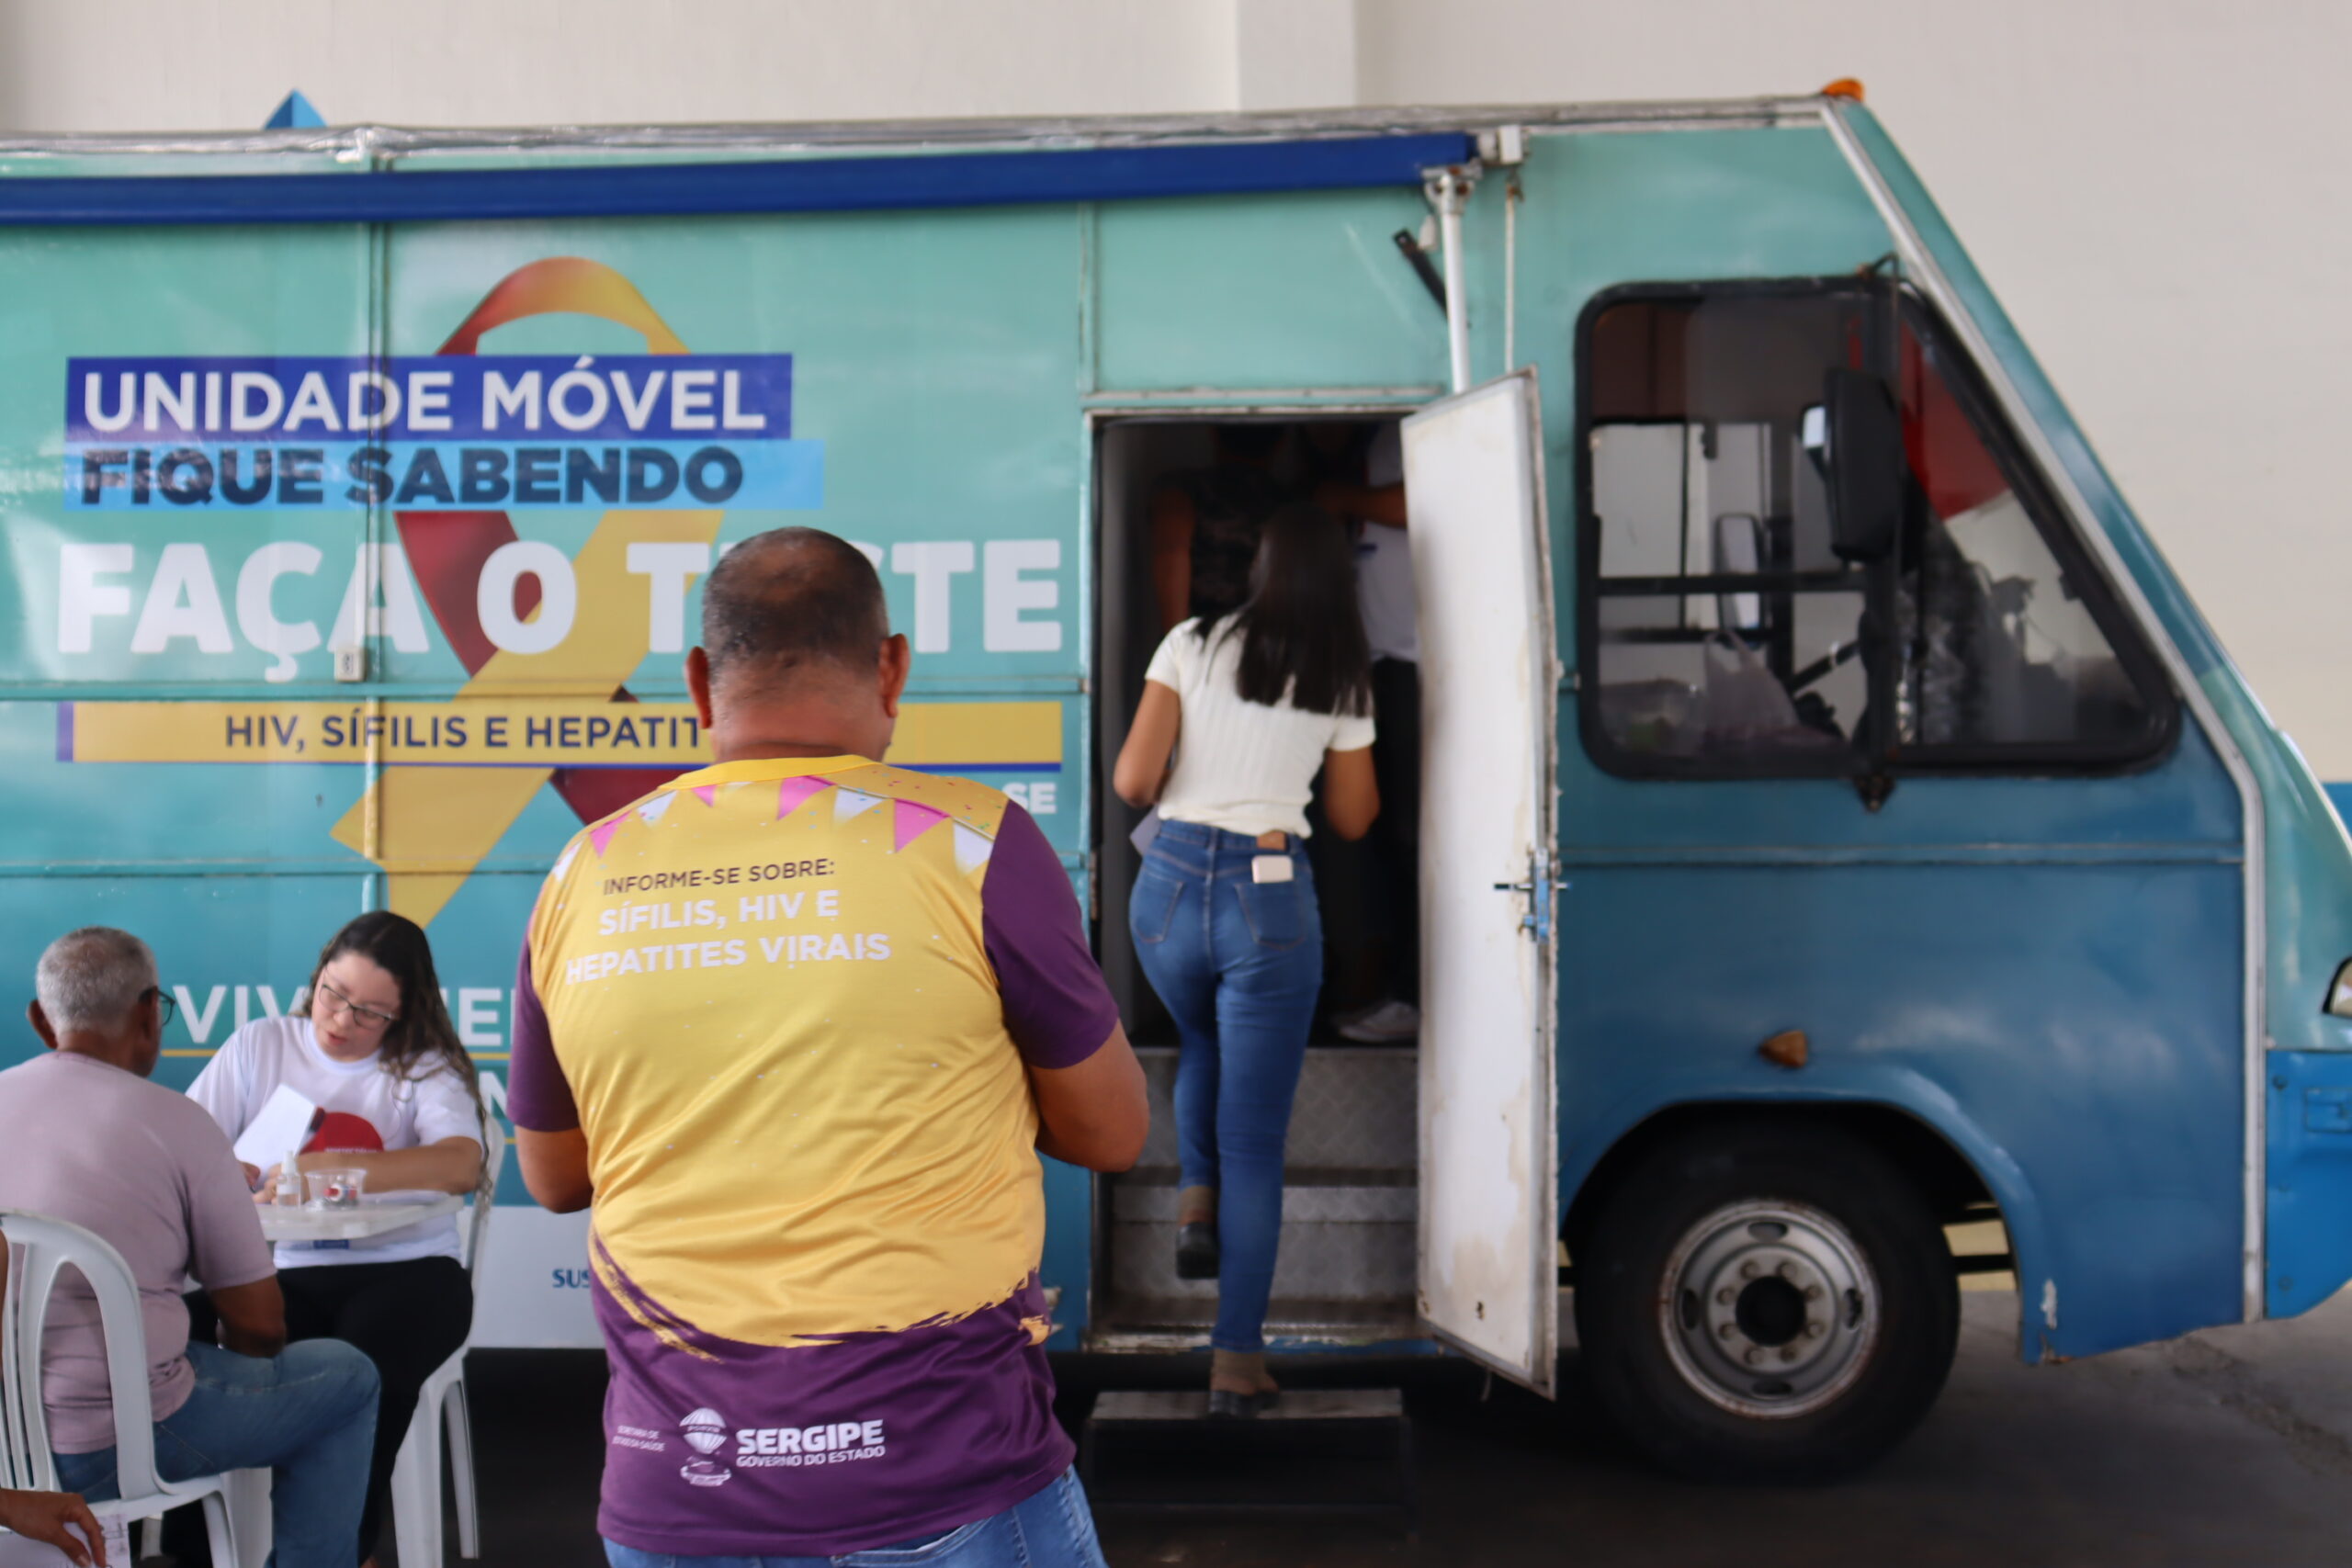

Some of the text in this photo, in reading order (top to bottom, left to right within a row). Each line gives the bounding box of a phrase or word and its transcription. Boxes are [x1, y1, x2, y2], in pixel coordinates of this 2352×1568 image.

[84, 355, 767, 433] UNIDADE MÓVEL
[81, 446, 744, 507] FIQUE SABENDO
[57, 538, 1062, 682] FAÇA O TTE
[226, 707, 699, 753] HIV, SÍFILIS E HEPATIT
[603, 858, 836, 897] INFORME-SE SOBRE:
[598, 889, 840, 936] SÍFILIS, HIV E
[565, 932, 891, 986] HEPATITES VIRAIS
[736, 1419, 886, 1455] SERGIPE
[736, 1445, 887, 1468] GOVERNO DO ESTADO
